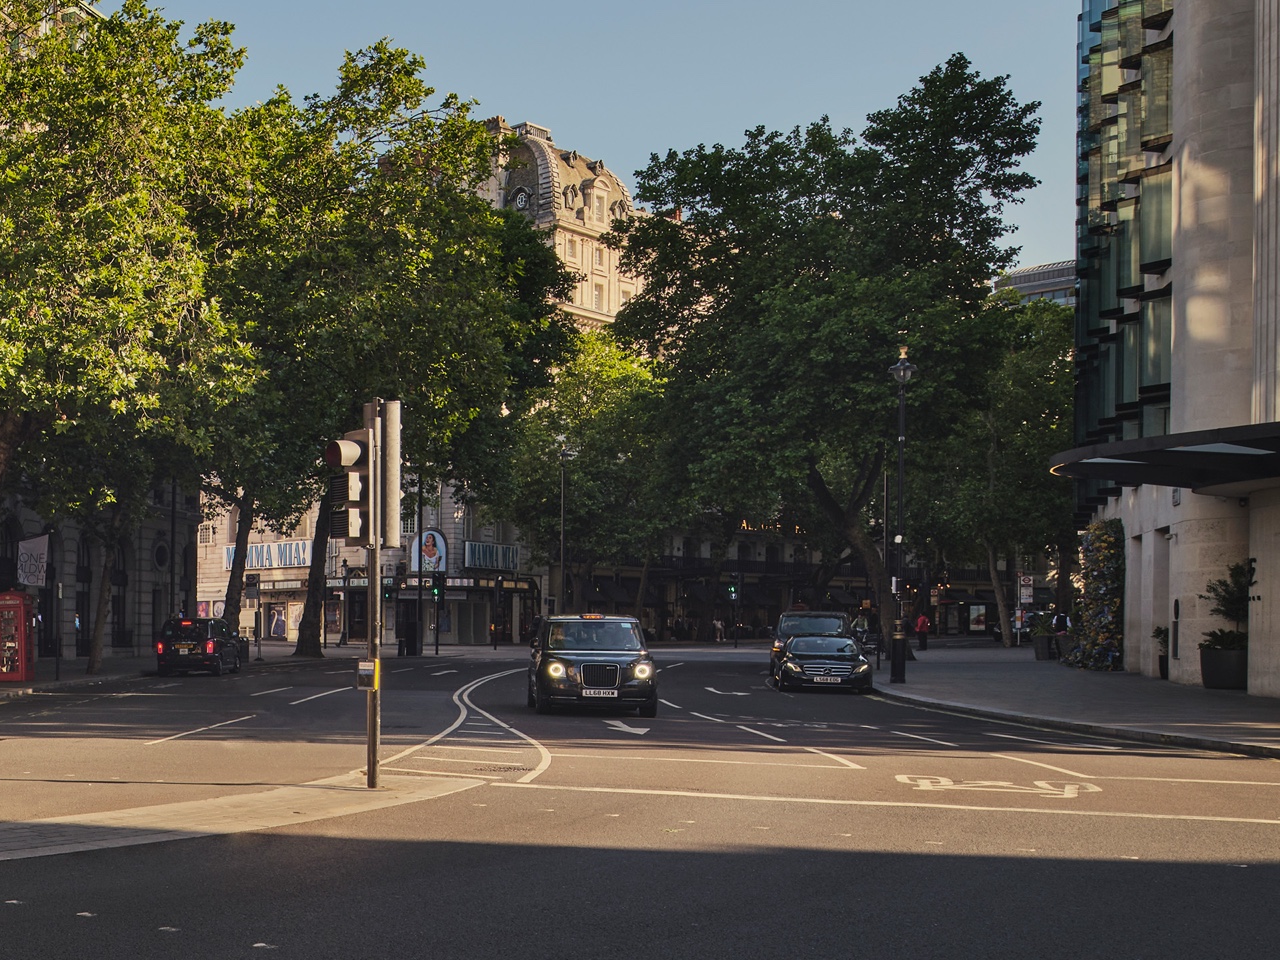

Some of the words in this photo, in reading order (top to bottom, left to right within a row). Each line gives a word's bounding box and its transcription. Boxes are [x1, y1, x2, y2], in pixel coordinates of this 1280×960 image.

[19, 552, 47, 564] ONE
[226, 545, 273, 569] MMMA
[277, 541, 307, 567] MIA!
[470, 543, 499, 569] MAMMA
